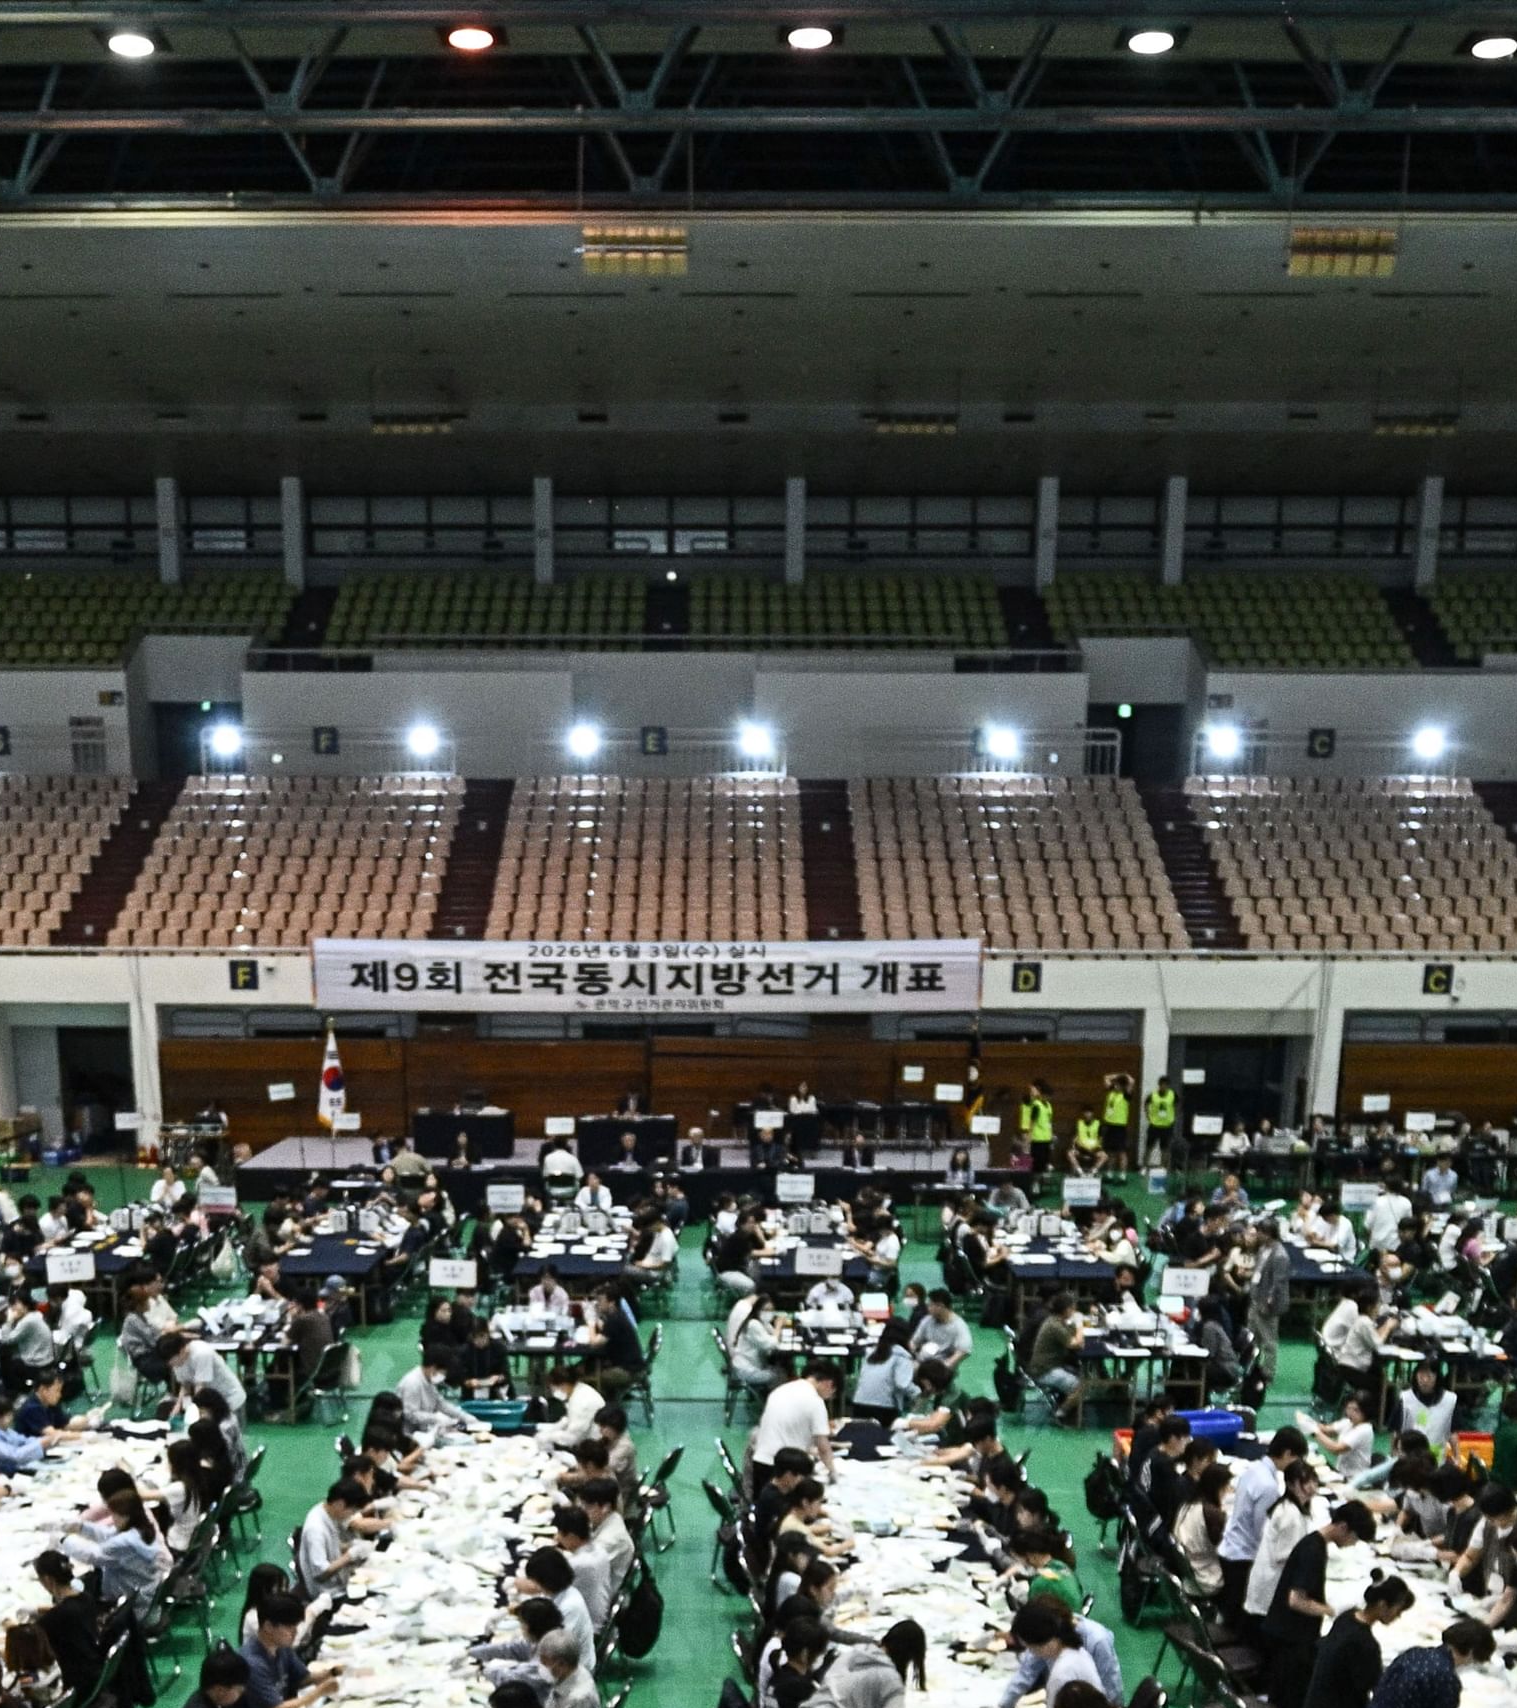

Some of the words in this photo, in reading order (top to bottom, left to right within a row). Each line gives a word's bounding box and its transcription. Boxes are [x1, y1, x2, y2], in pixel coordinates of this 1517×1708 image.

[528, 945, 600, 958] 2026년
[236, 966, 251, 988] F
[349, 959, 463, 994] 제9회
[483, 961, 839, 996] 전국동시지방선거
[860, 960, 947, 994] 개표
[1017, 968, 1037, 992] D
[1428, 968, 1447, 993] C
